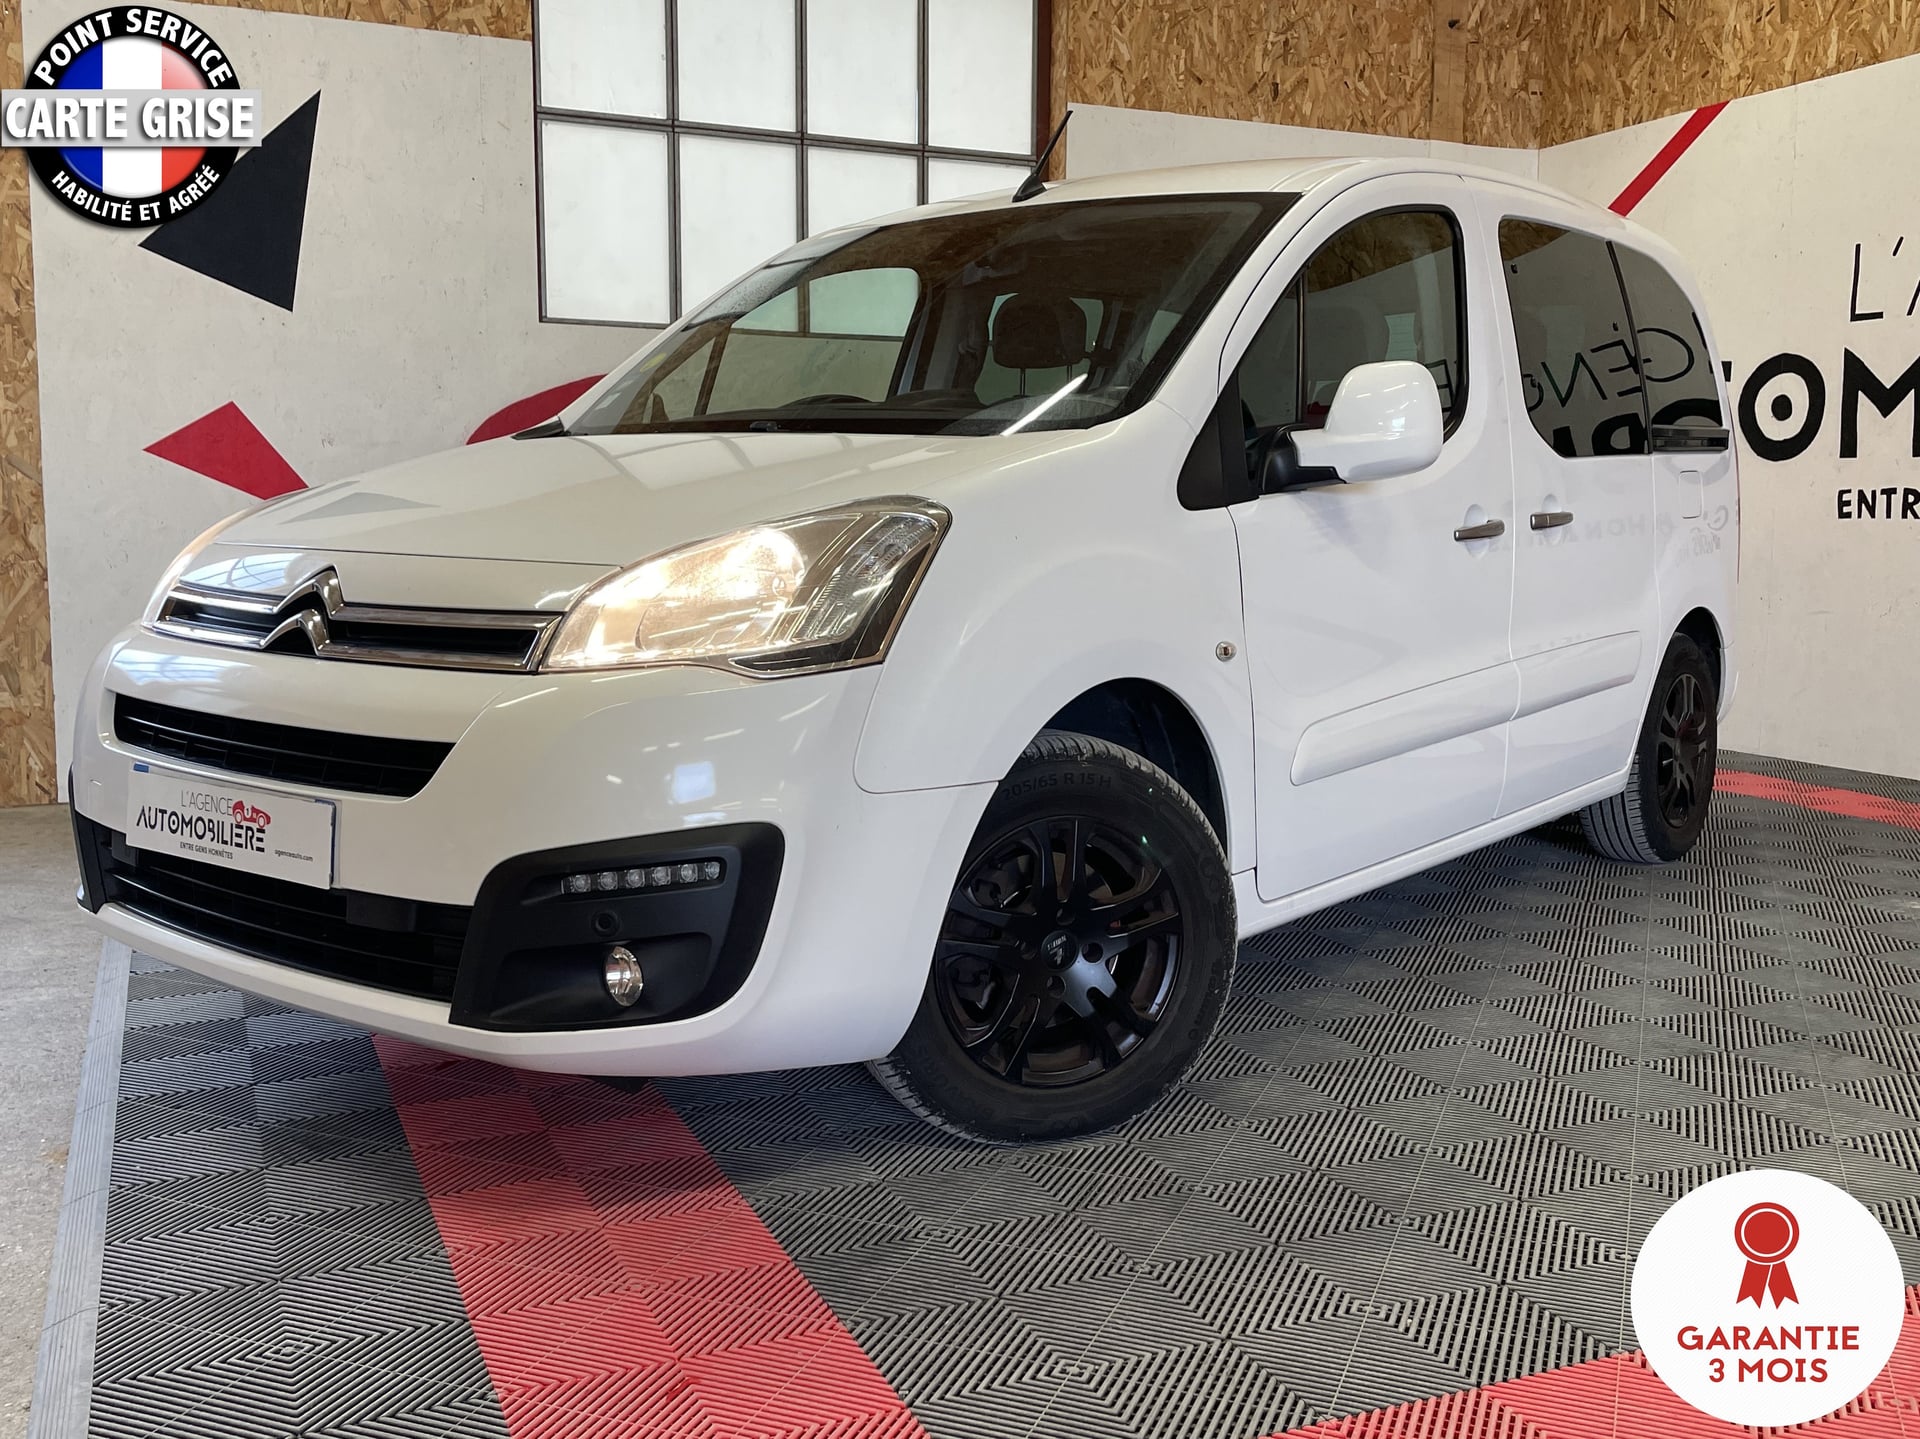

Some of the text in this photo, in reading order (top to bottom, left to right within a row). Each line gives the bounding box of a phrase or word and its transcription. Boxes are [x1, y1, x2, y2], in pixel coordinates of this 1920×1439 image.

[1001, 773, 1058, 801] 205/65
[181, 789, 233, 816] L'AGENCE
[180, 841, 194, 852] ENTRE
